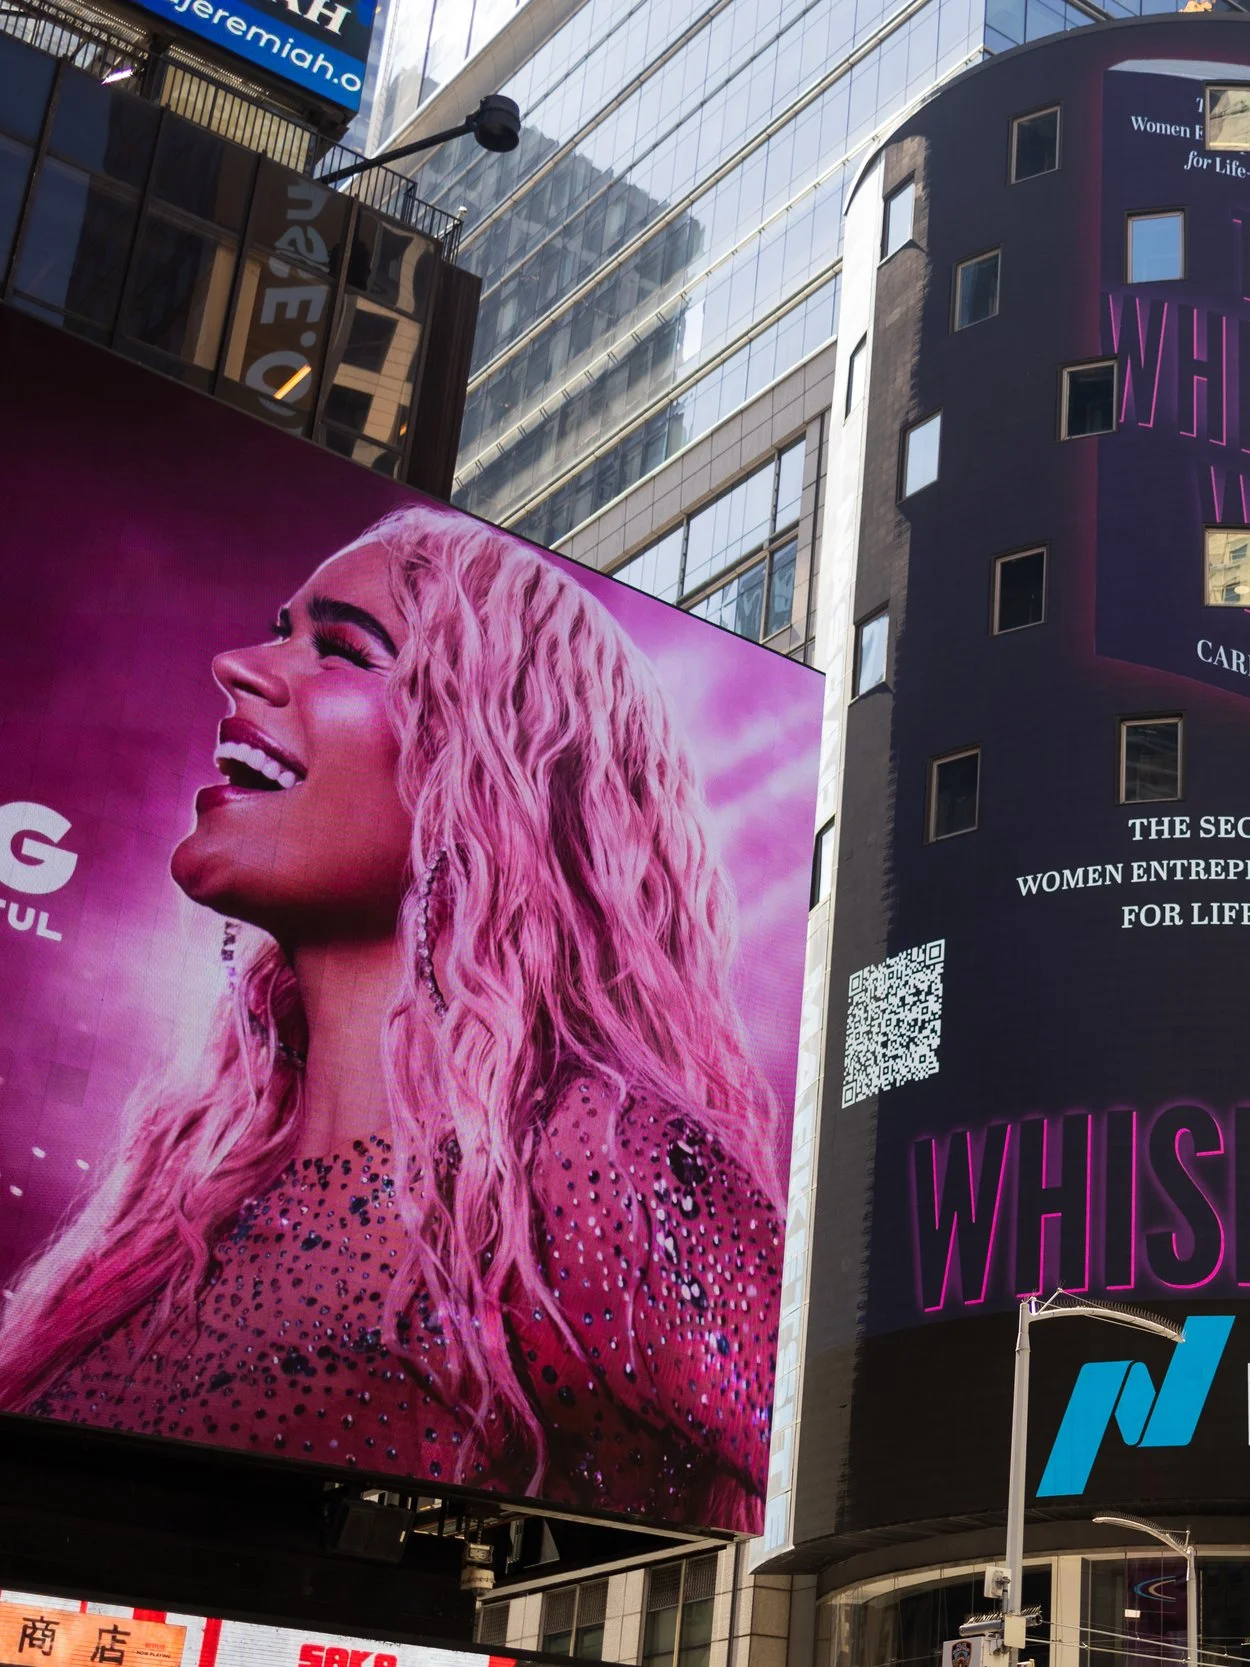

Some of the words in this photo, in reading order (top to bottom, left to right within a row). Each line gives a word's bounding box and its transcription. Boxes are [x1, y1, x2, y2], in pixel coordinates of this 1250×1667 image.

[1131, 116, 1190, 139] Women
[1184, 151, 1212, 170] for
[1128, 816, 1191, 841] THE
[1016, 863, 1124, 896] WOMEN
[0, 899, 62, 941] UL
[1121, 903, 1183, 929] FOR
[18, 1616, 131, 1666] 商店
